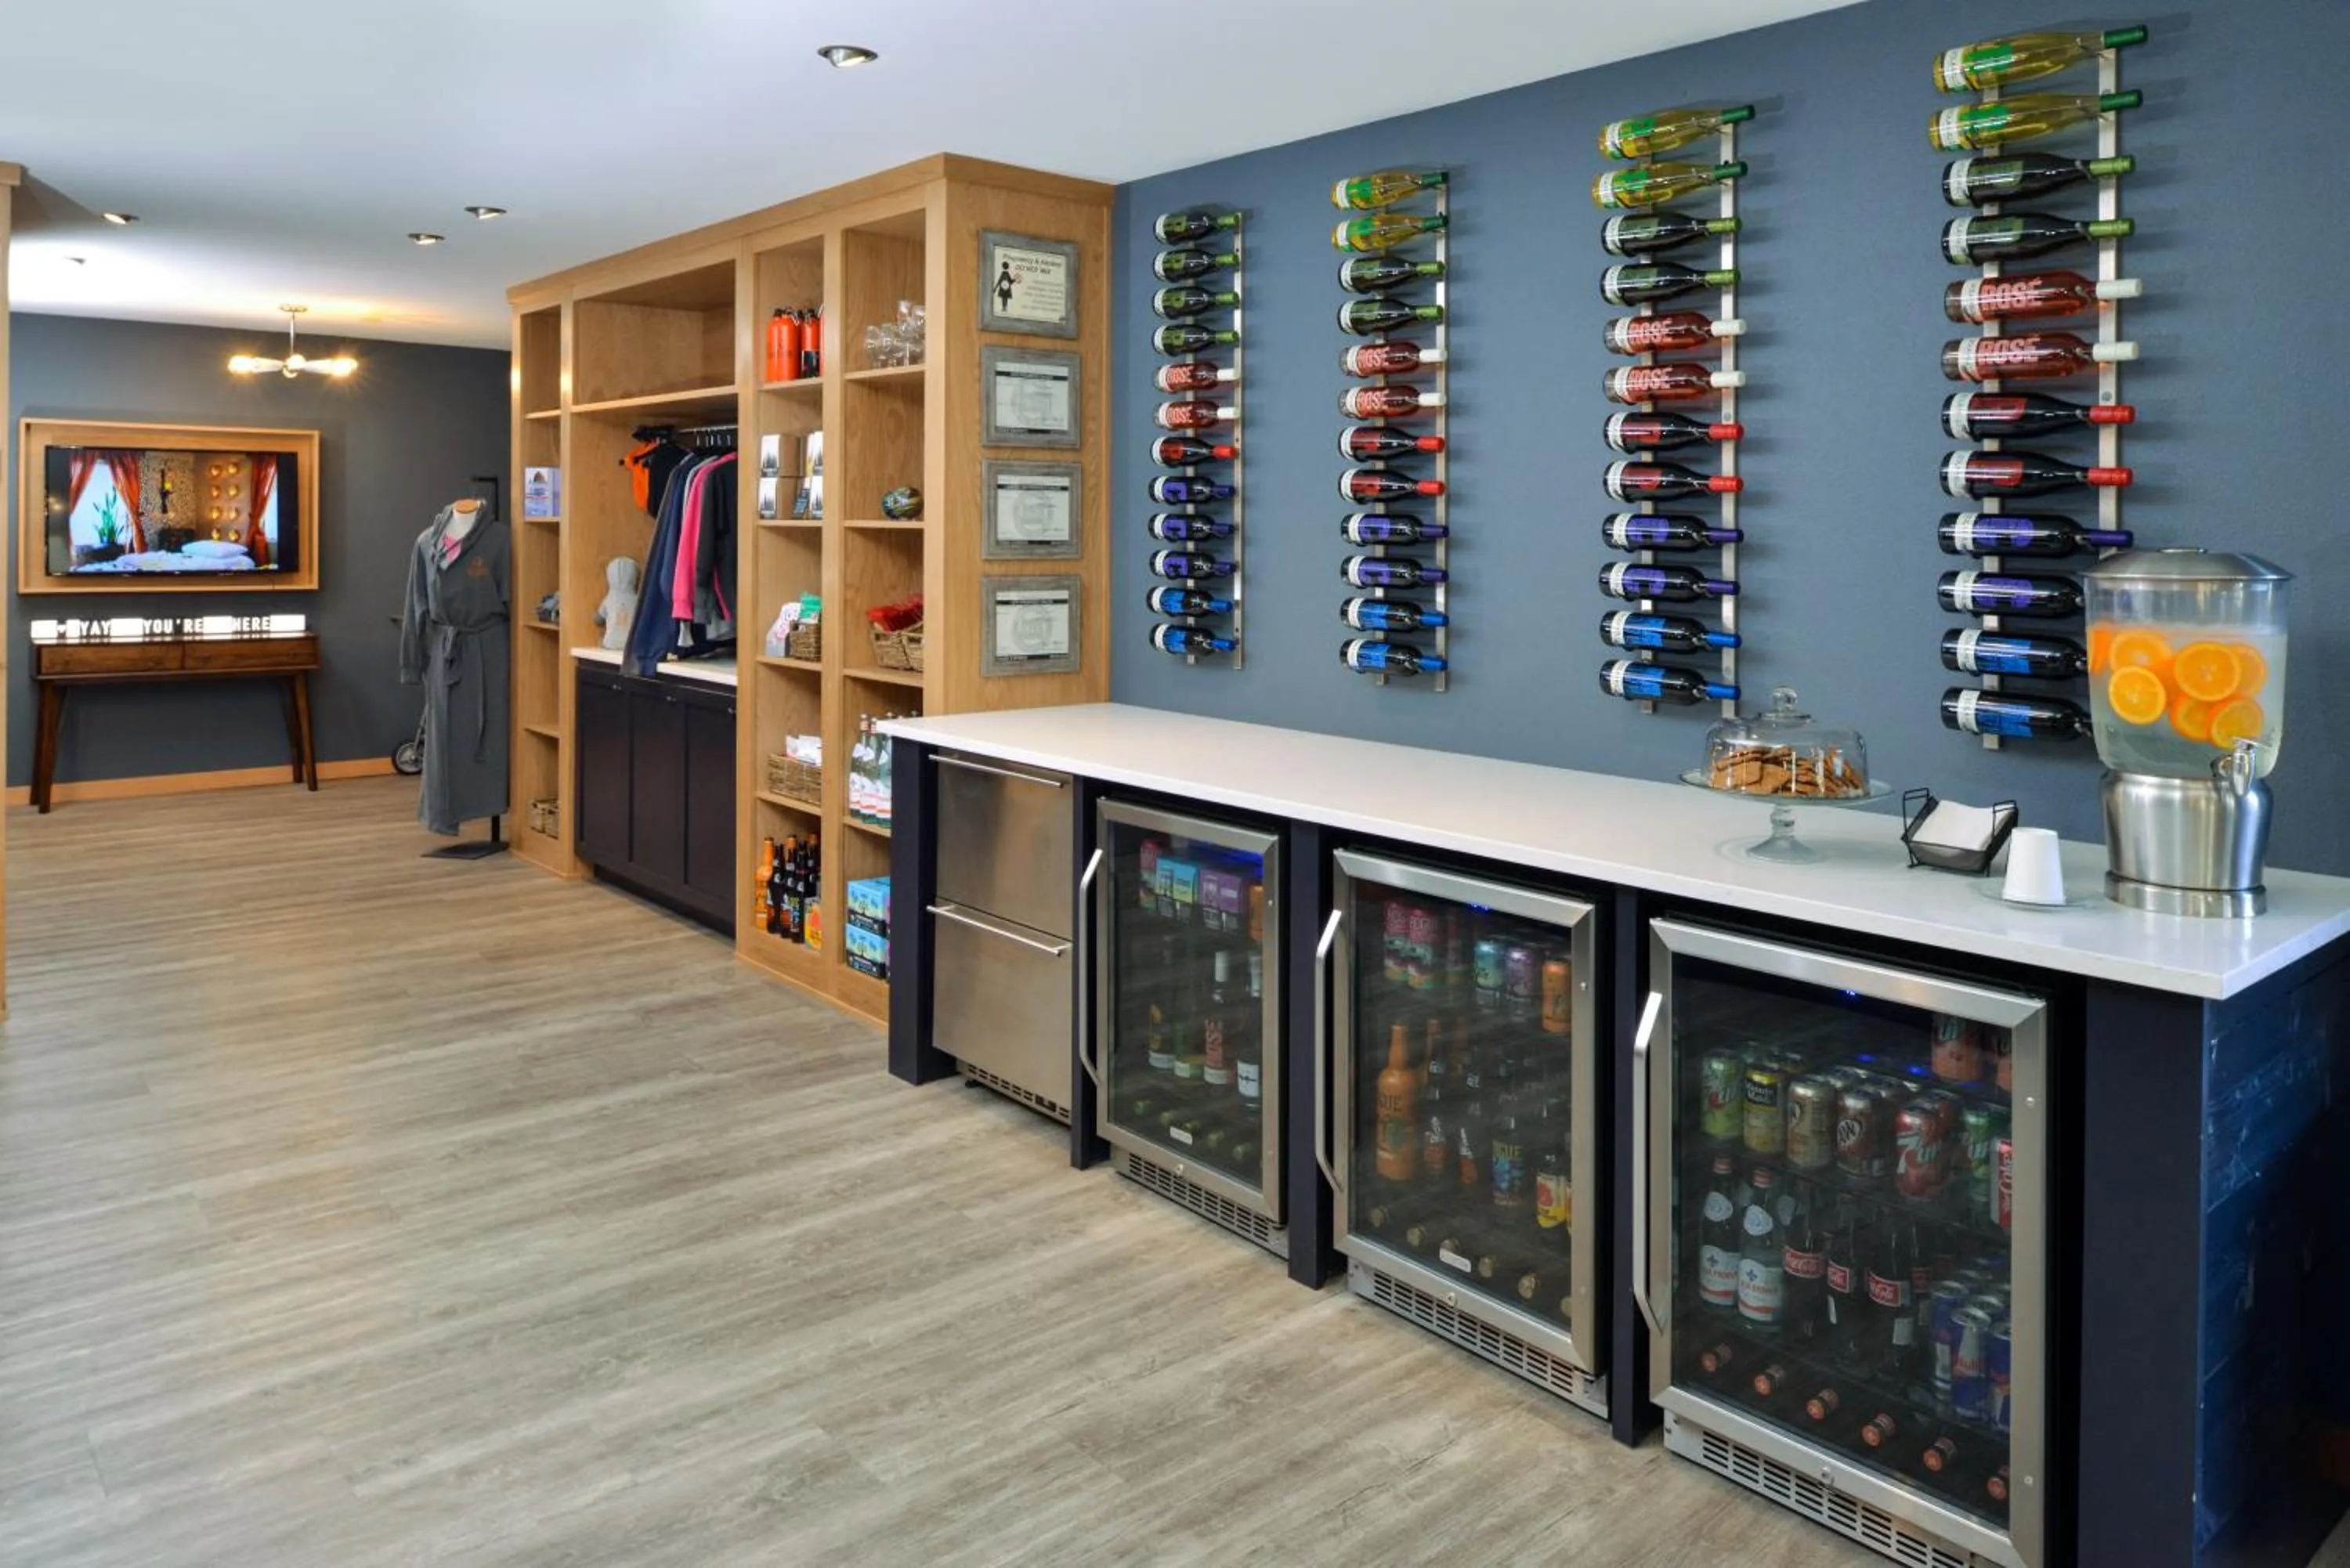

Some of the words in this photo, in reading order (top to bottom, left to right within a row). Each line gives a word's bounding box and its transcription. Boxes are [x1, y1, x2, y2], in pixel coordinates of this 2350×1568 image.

[80, 619, 111, 636] YAY
[143, 617, 203, 634] YOU'RE
[233, 616, 269, 632] HERE
